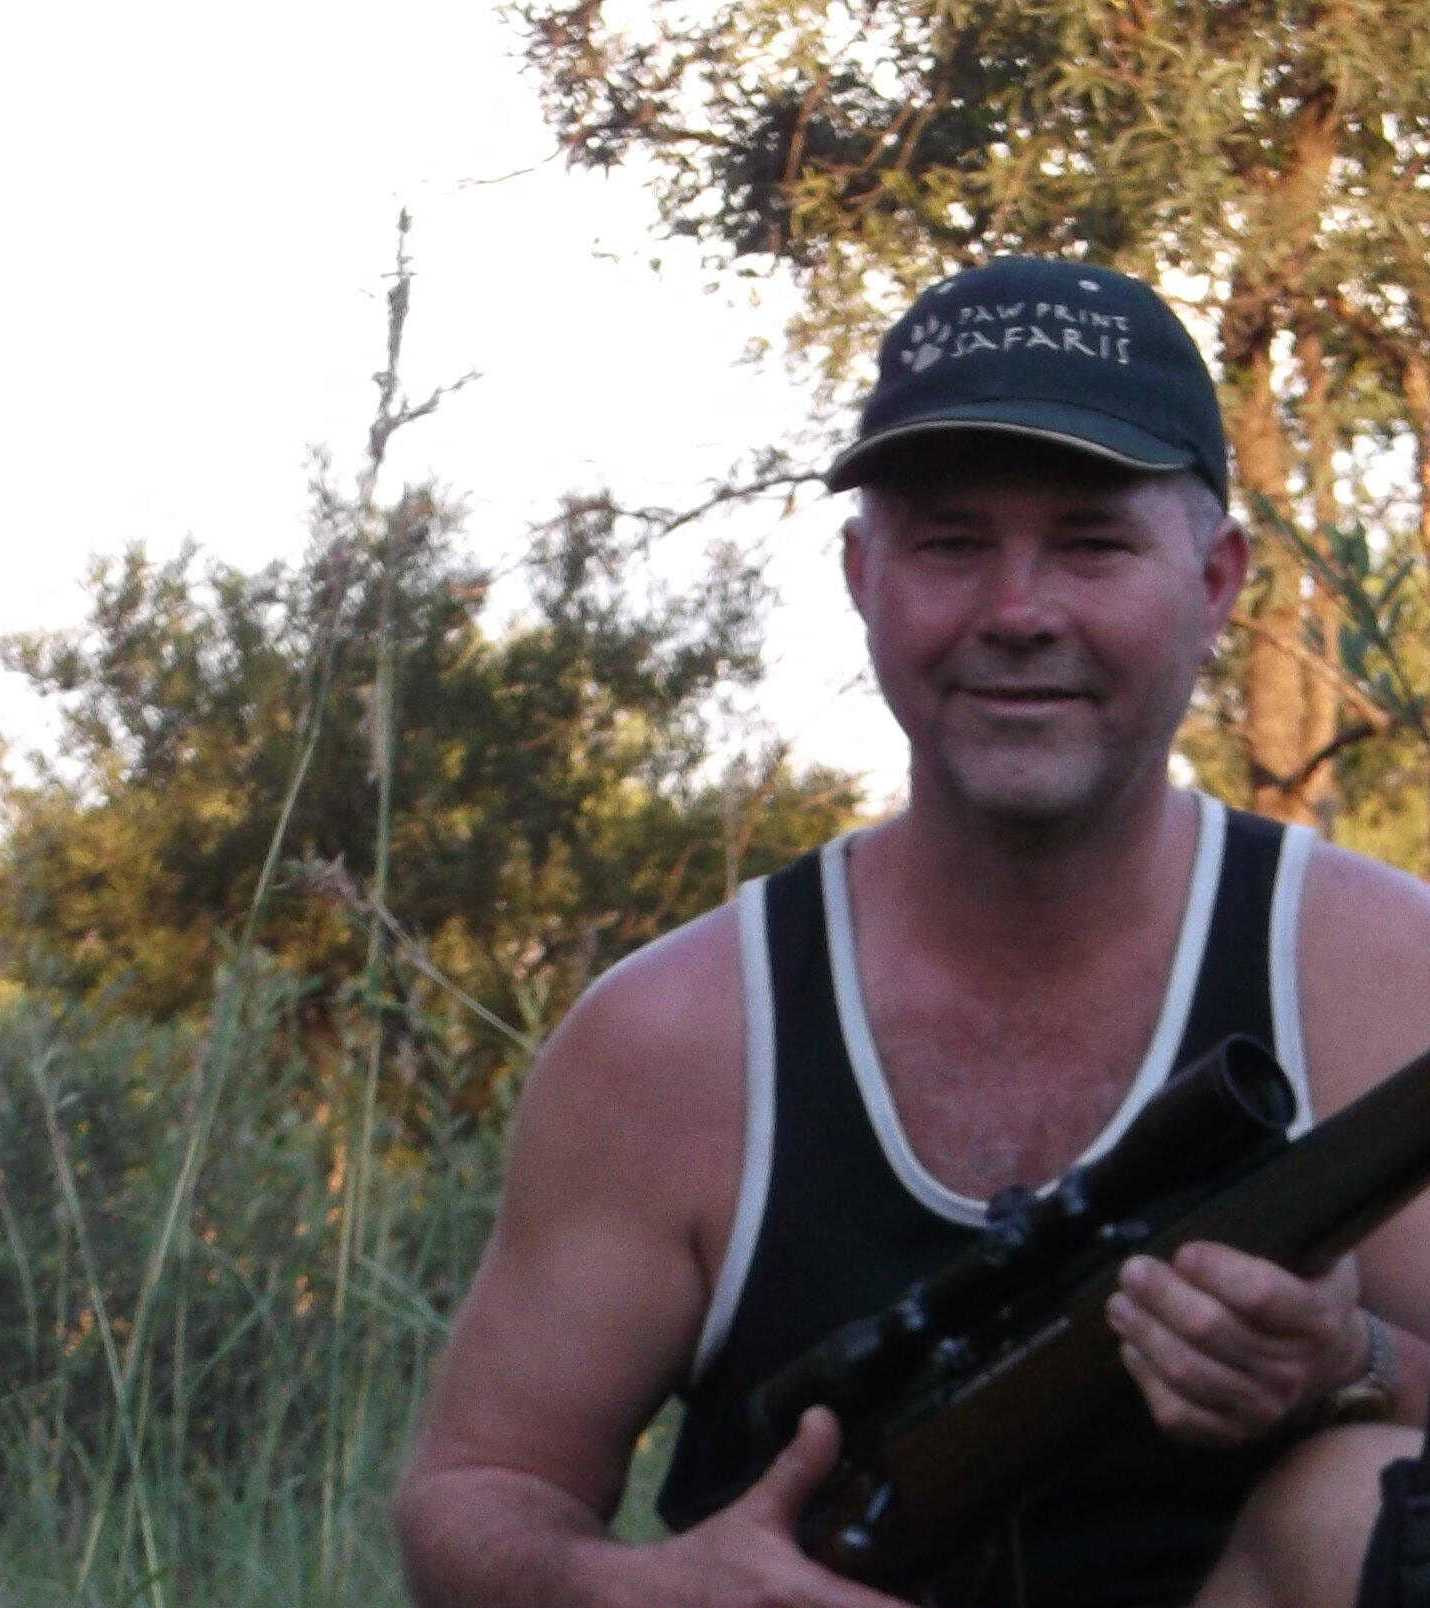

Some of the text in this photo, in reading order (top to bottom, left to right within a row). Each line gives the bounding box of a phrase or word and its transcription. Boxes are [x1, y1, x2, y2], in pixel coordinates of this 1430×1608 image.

[959, 302, 1129, 331] PAW PRINT
[950, 326, 1131, 366] SAFARIS
